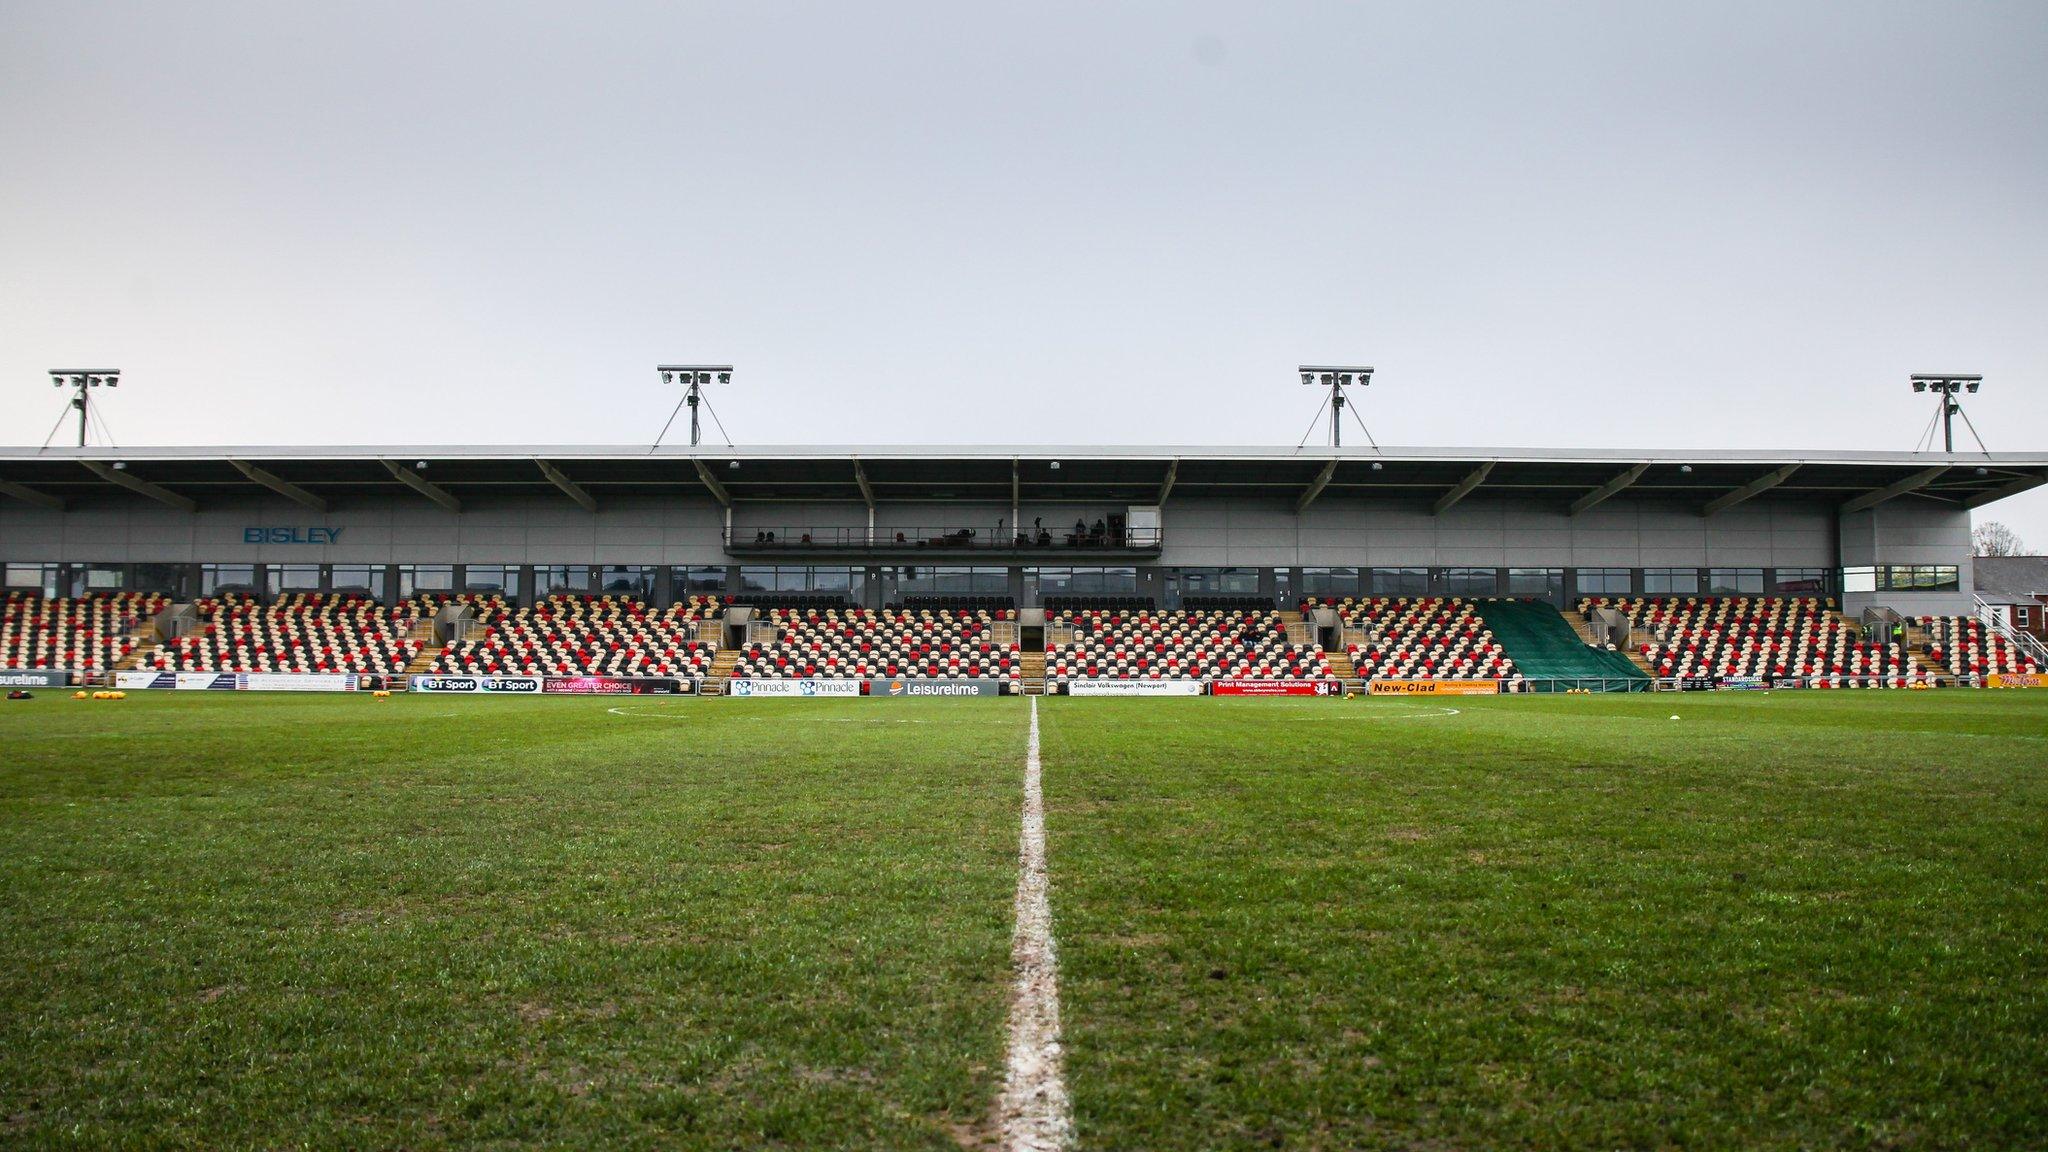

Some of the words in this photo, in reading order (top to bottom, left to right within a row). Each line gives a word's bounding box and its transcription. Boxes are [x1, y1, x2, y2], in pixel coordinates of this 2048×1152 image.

[243, 527, 343, 544] BISLEY
[428, 680, 443, 688] BT
[445, 680, 474, 690] Sport
[505, 681, 534, 691] Sport
[751, 681, 790, 692] Pinnacle
[816, 681, 854, 692] Pinnacle
[907, 683, 979, 695] Leisuretime
[1097, 682, 1135, 690] Volkswagen
[1136, 682, 1167, 690] (Newport)
[1235, 681, 1279, 689] Management
[1374, 683, 1435, 692] New-Clad
